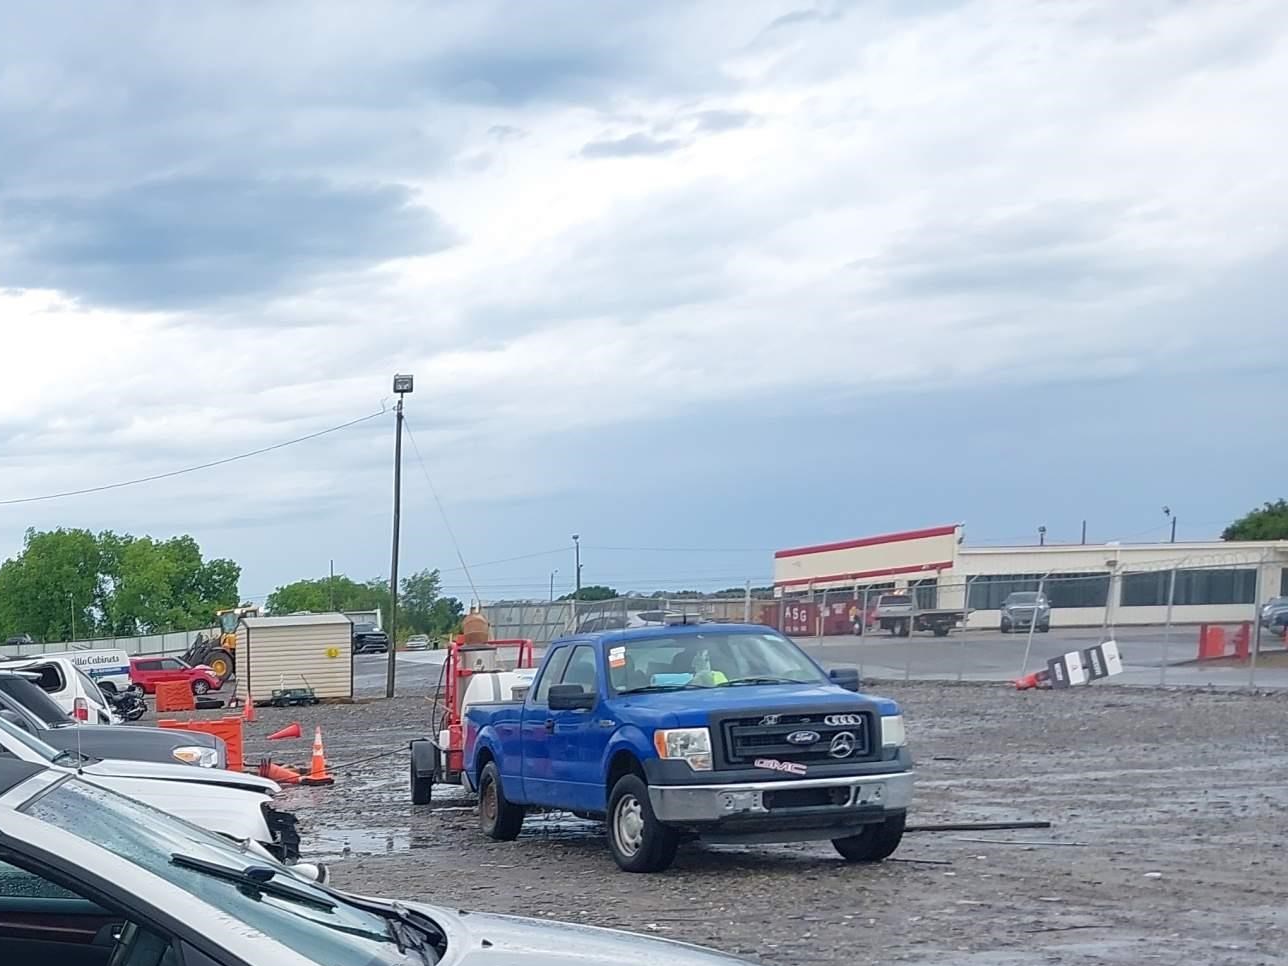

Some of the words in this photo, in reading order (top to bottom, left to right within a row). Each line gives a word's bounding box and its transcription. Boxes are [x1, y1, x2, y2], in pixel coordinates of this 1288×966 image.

[785, 606, 807, 622] ASG
[87, 655, 120, 665] Cabinets
[754, 758, 808, 776] GMC
